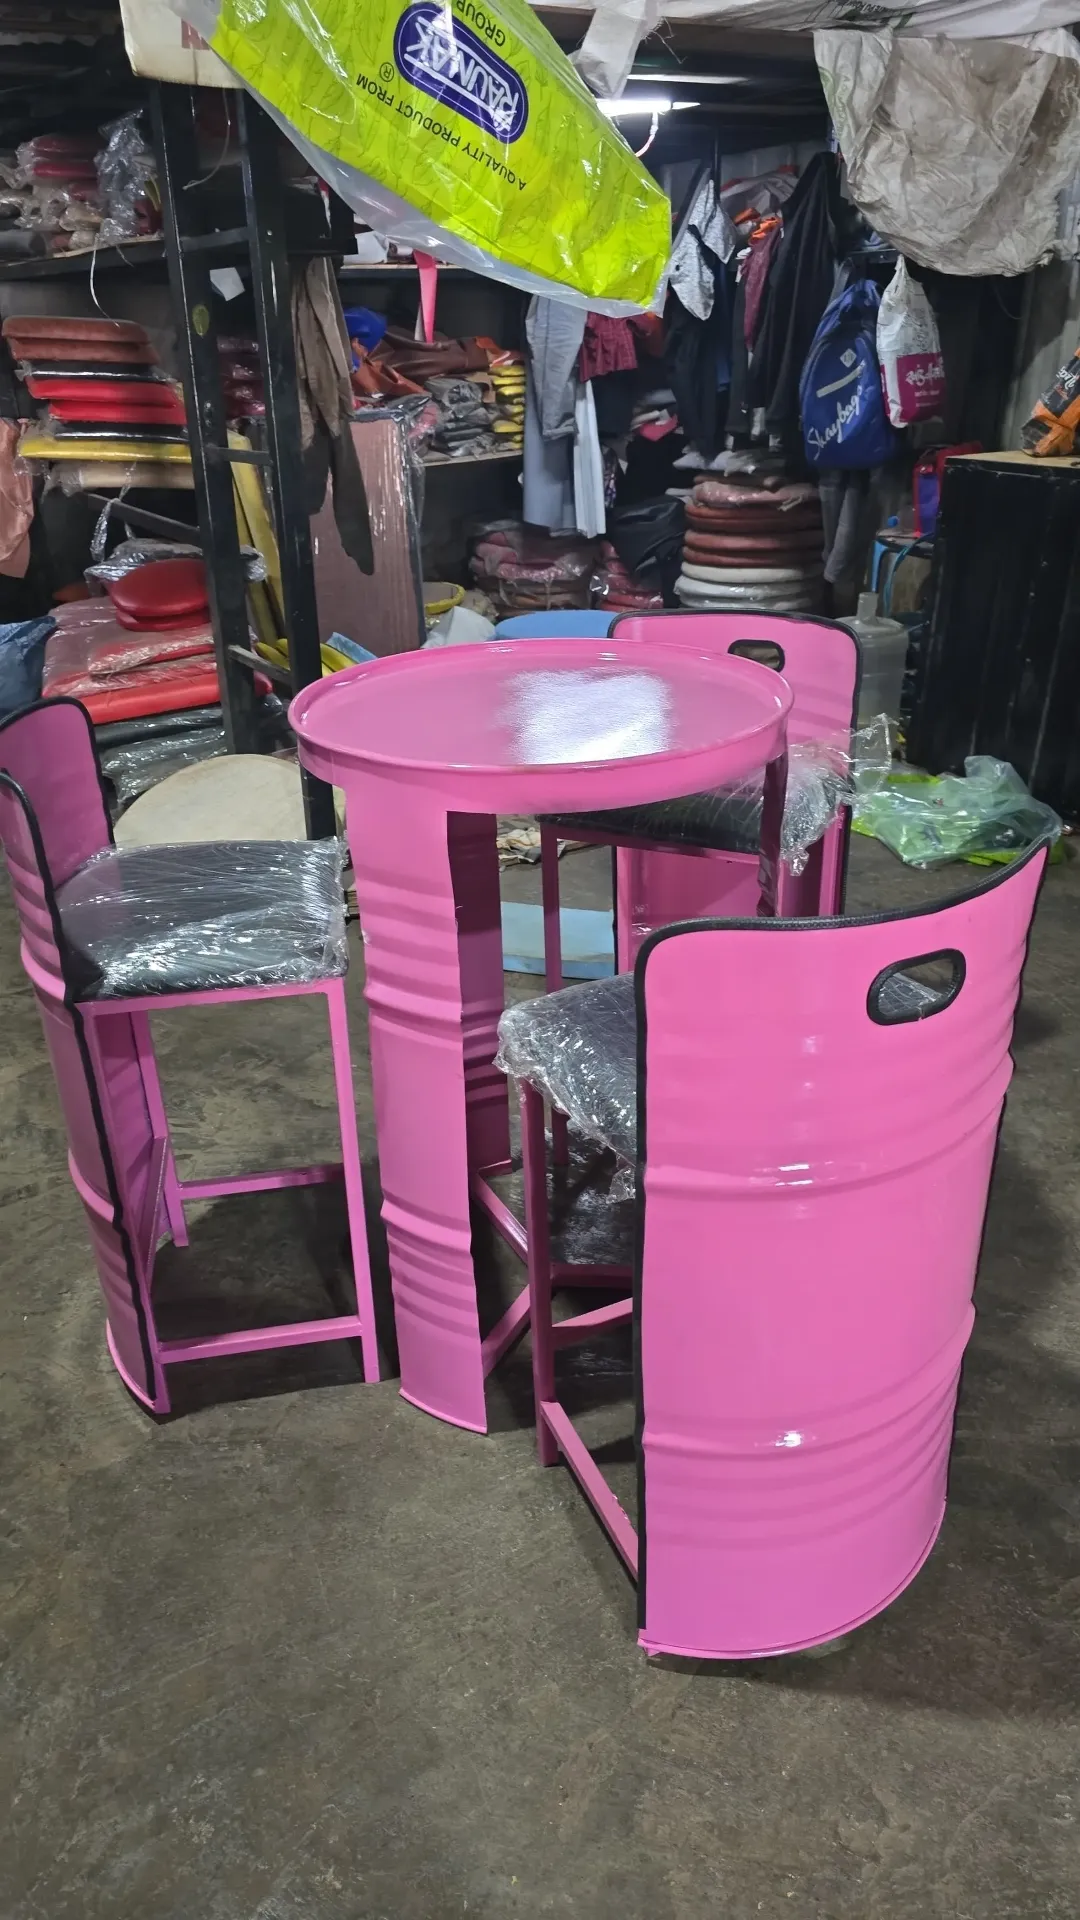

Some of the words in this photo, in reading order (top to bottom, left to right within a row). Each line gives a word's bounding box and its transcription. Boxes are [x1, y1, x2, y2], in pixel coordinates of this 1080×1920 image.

[456, 0, 506, 47] GROUP
[356, 73, 395, 106] FROM
[396, 103, 461, 148] PRODUCT
[461, 142, 517, 185] QUALITY
[518, 178, 527, 191] A
